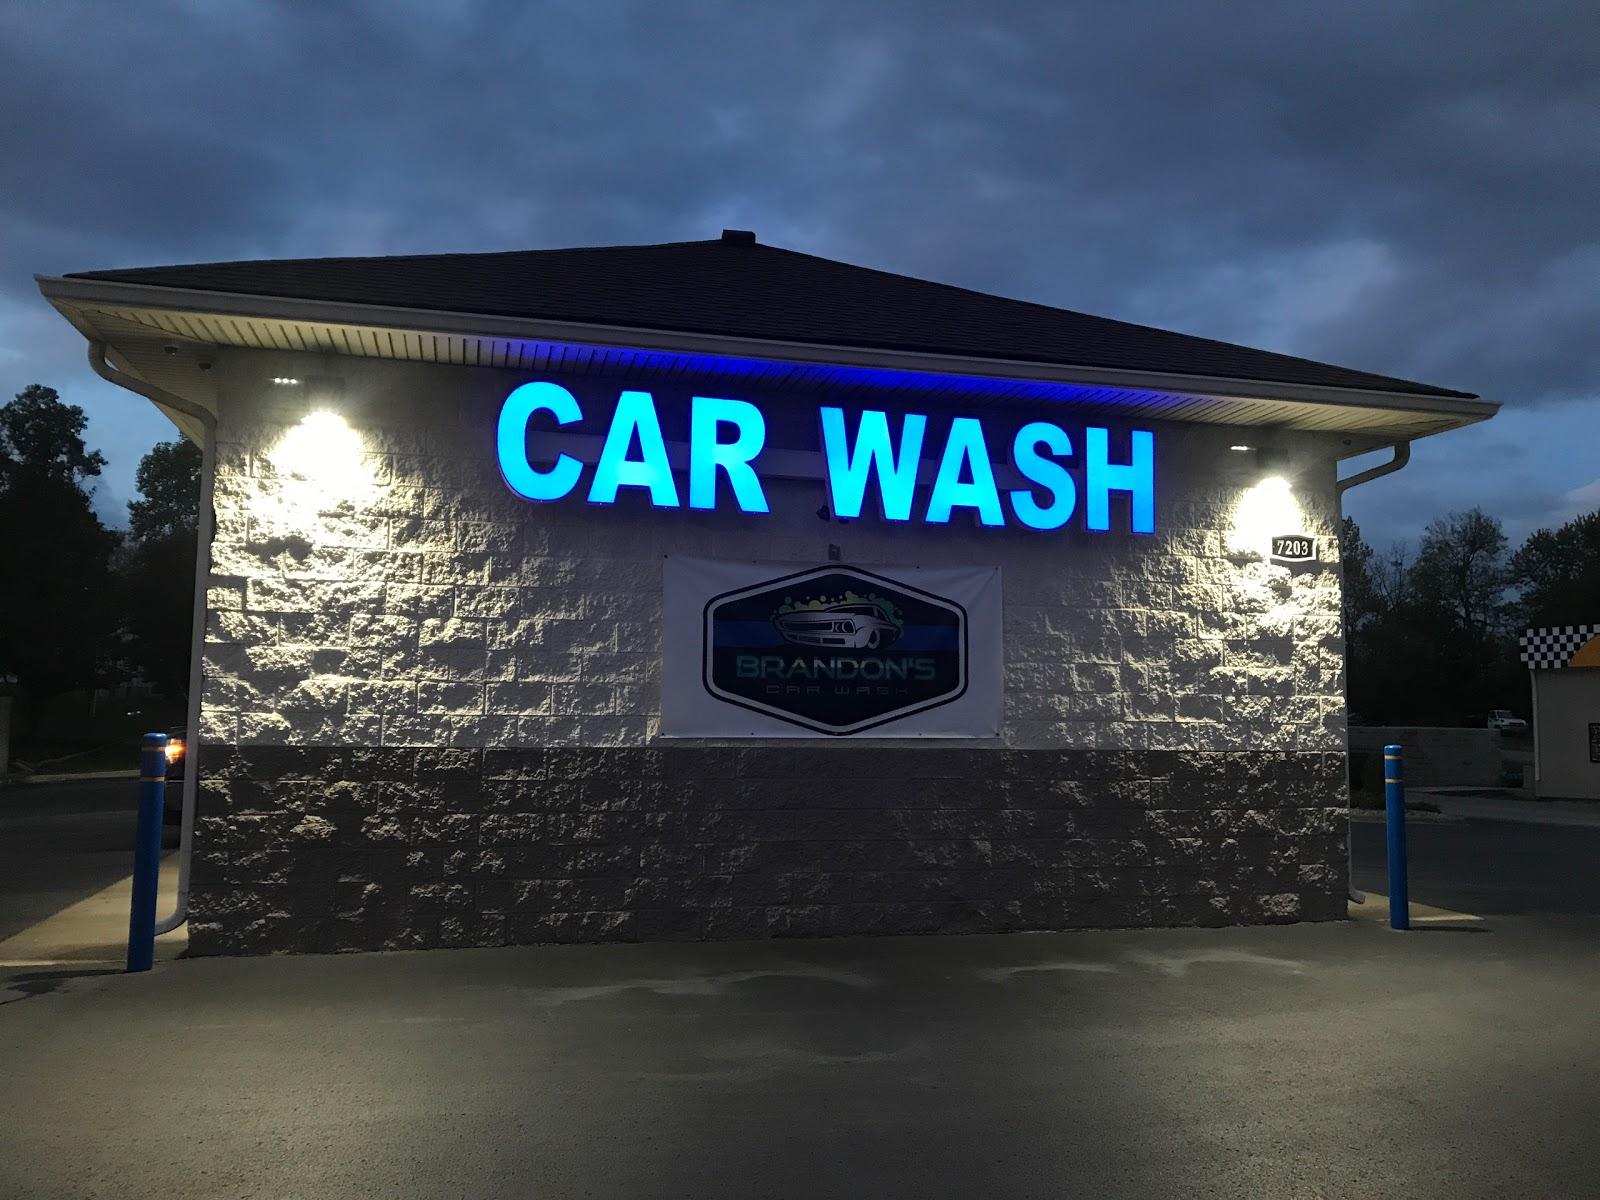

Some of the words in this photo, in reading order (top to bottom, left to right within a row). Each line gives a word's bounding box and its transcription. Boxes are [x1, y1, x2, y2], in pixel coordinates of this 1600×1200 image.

[497, 381, 769, 513] CAR
[820, 406, 1155, 534] WASH
[1277, 540, 1308, 555] 7203
[736, 655, 936, 680] BRANDON'S
[766, 685, 823, 696] CAR
[835, 685, 909, 696] WASH
